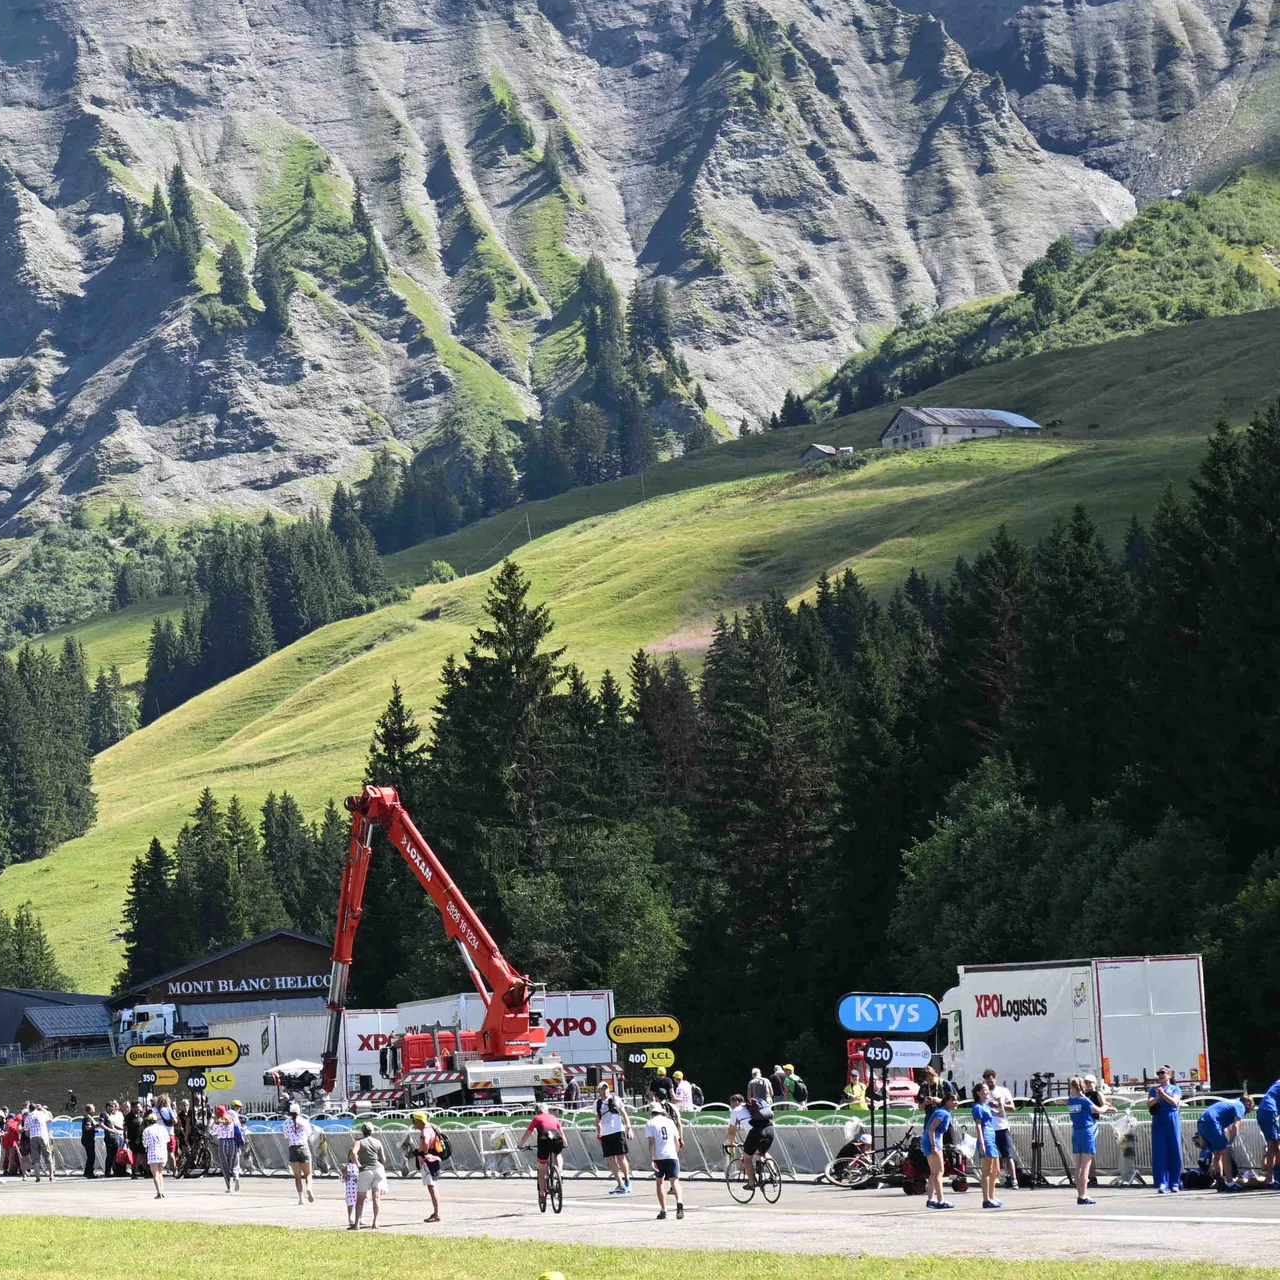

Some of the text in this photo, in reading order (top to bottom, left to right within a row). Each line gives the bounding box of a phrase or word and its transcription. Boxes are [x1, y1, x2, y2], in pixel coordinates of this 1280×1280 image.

[406, 841, 432, 882] LOXAM
[466, 929, 479, 950] 1234
[167, 974, 332, 995] MONT BLANC HELICO
[854, 996, 920, 1030] Krys
[545, 1016, 597, 1038] XPO
[613, 1024, 666, 1037] Continental
[129, 1051, 165, 1061] Continent
[171, 1046, 225, 1061] Continental
[628, 1051, 671, 1064] 400 LCL
[866, 1047, 891, 1061] 450
[142, 1074, 156, 1083] 350
[187, 1074, 232, 1088] 400 LCL
